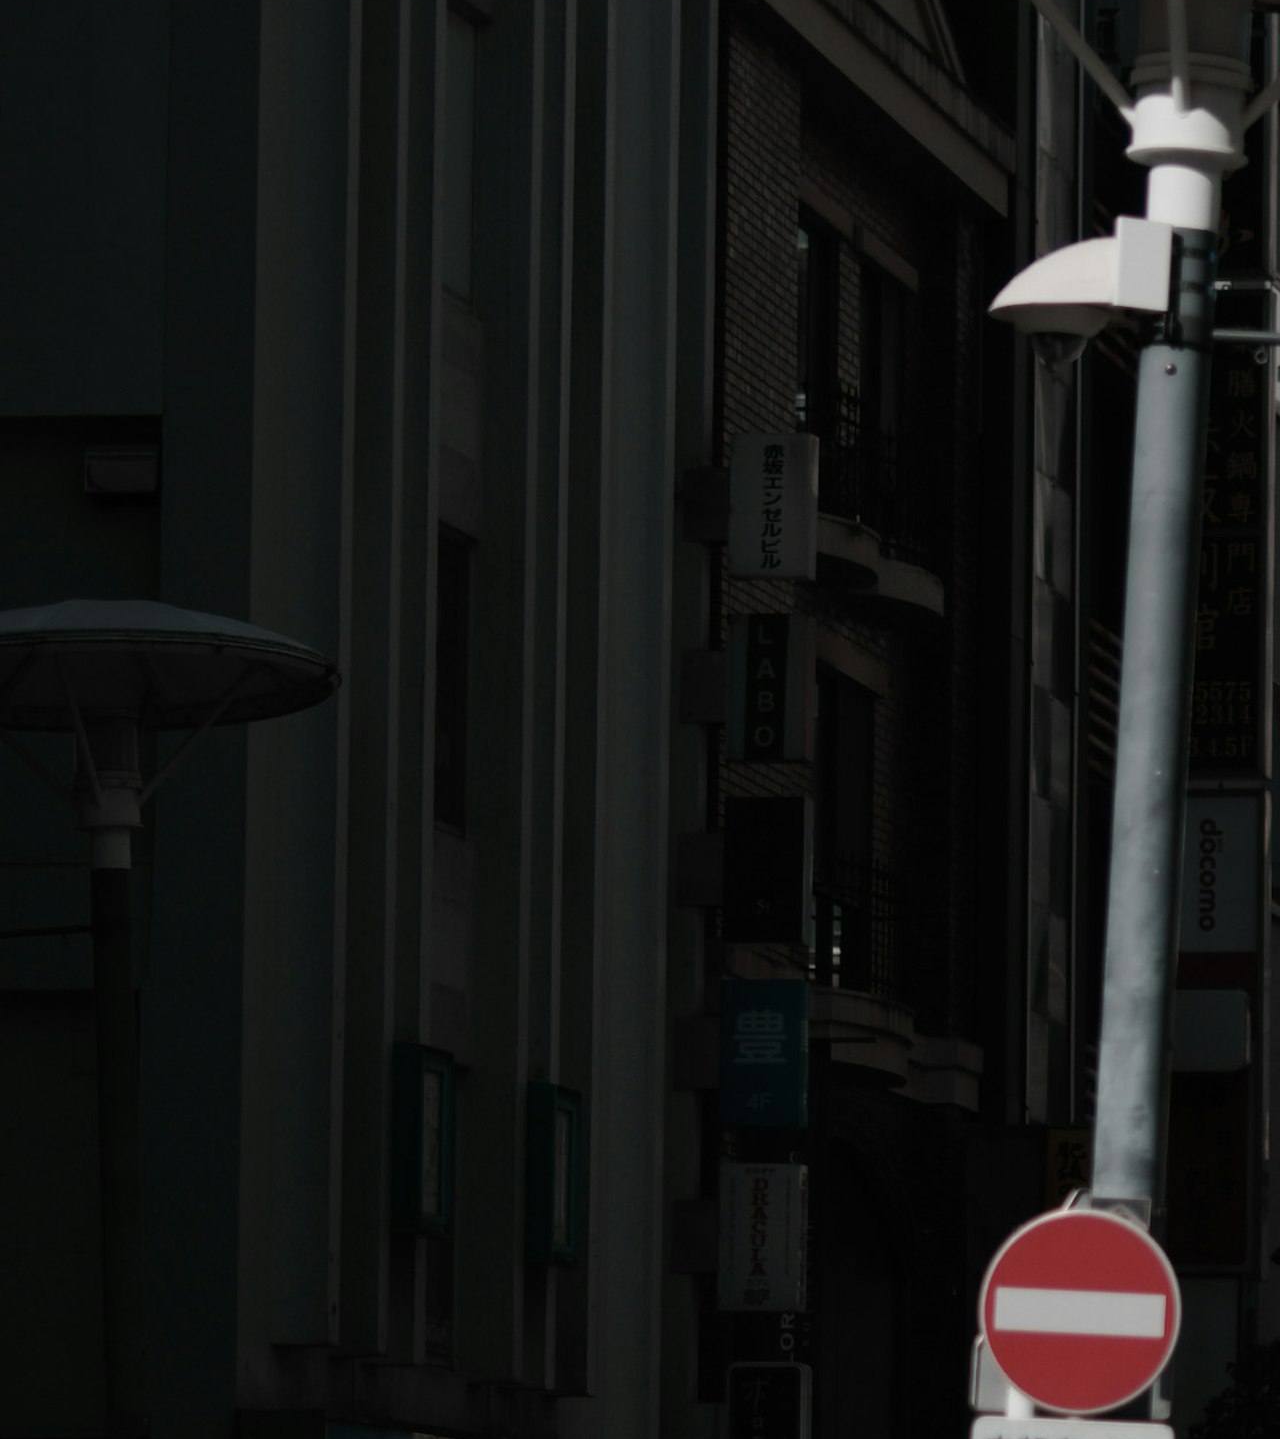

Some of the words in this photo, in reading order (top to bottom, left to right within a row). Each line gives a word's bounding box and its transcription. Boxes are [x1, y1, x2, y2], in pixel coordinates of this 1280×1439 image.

[761, 443, 785, 569] 赤坂エンゼルビル
[754, 625, 777, 748] LABO
[1199, 818, 1224, 931] docomo
[733, 1009, 787, 1064] 豊
[749, 1177, 770, 1277] DRACULA
